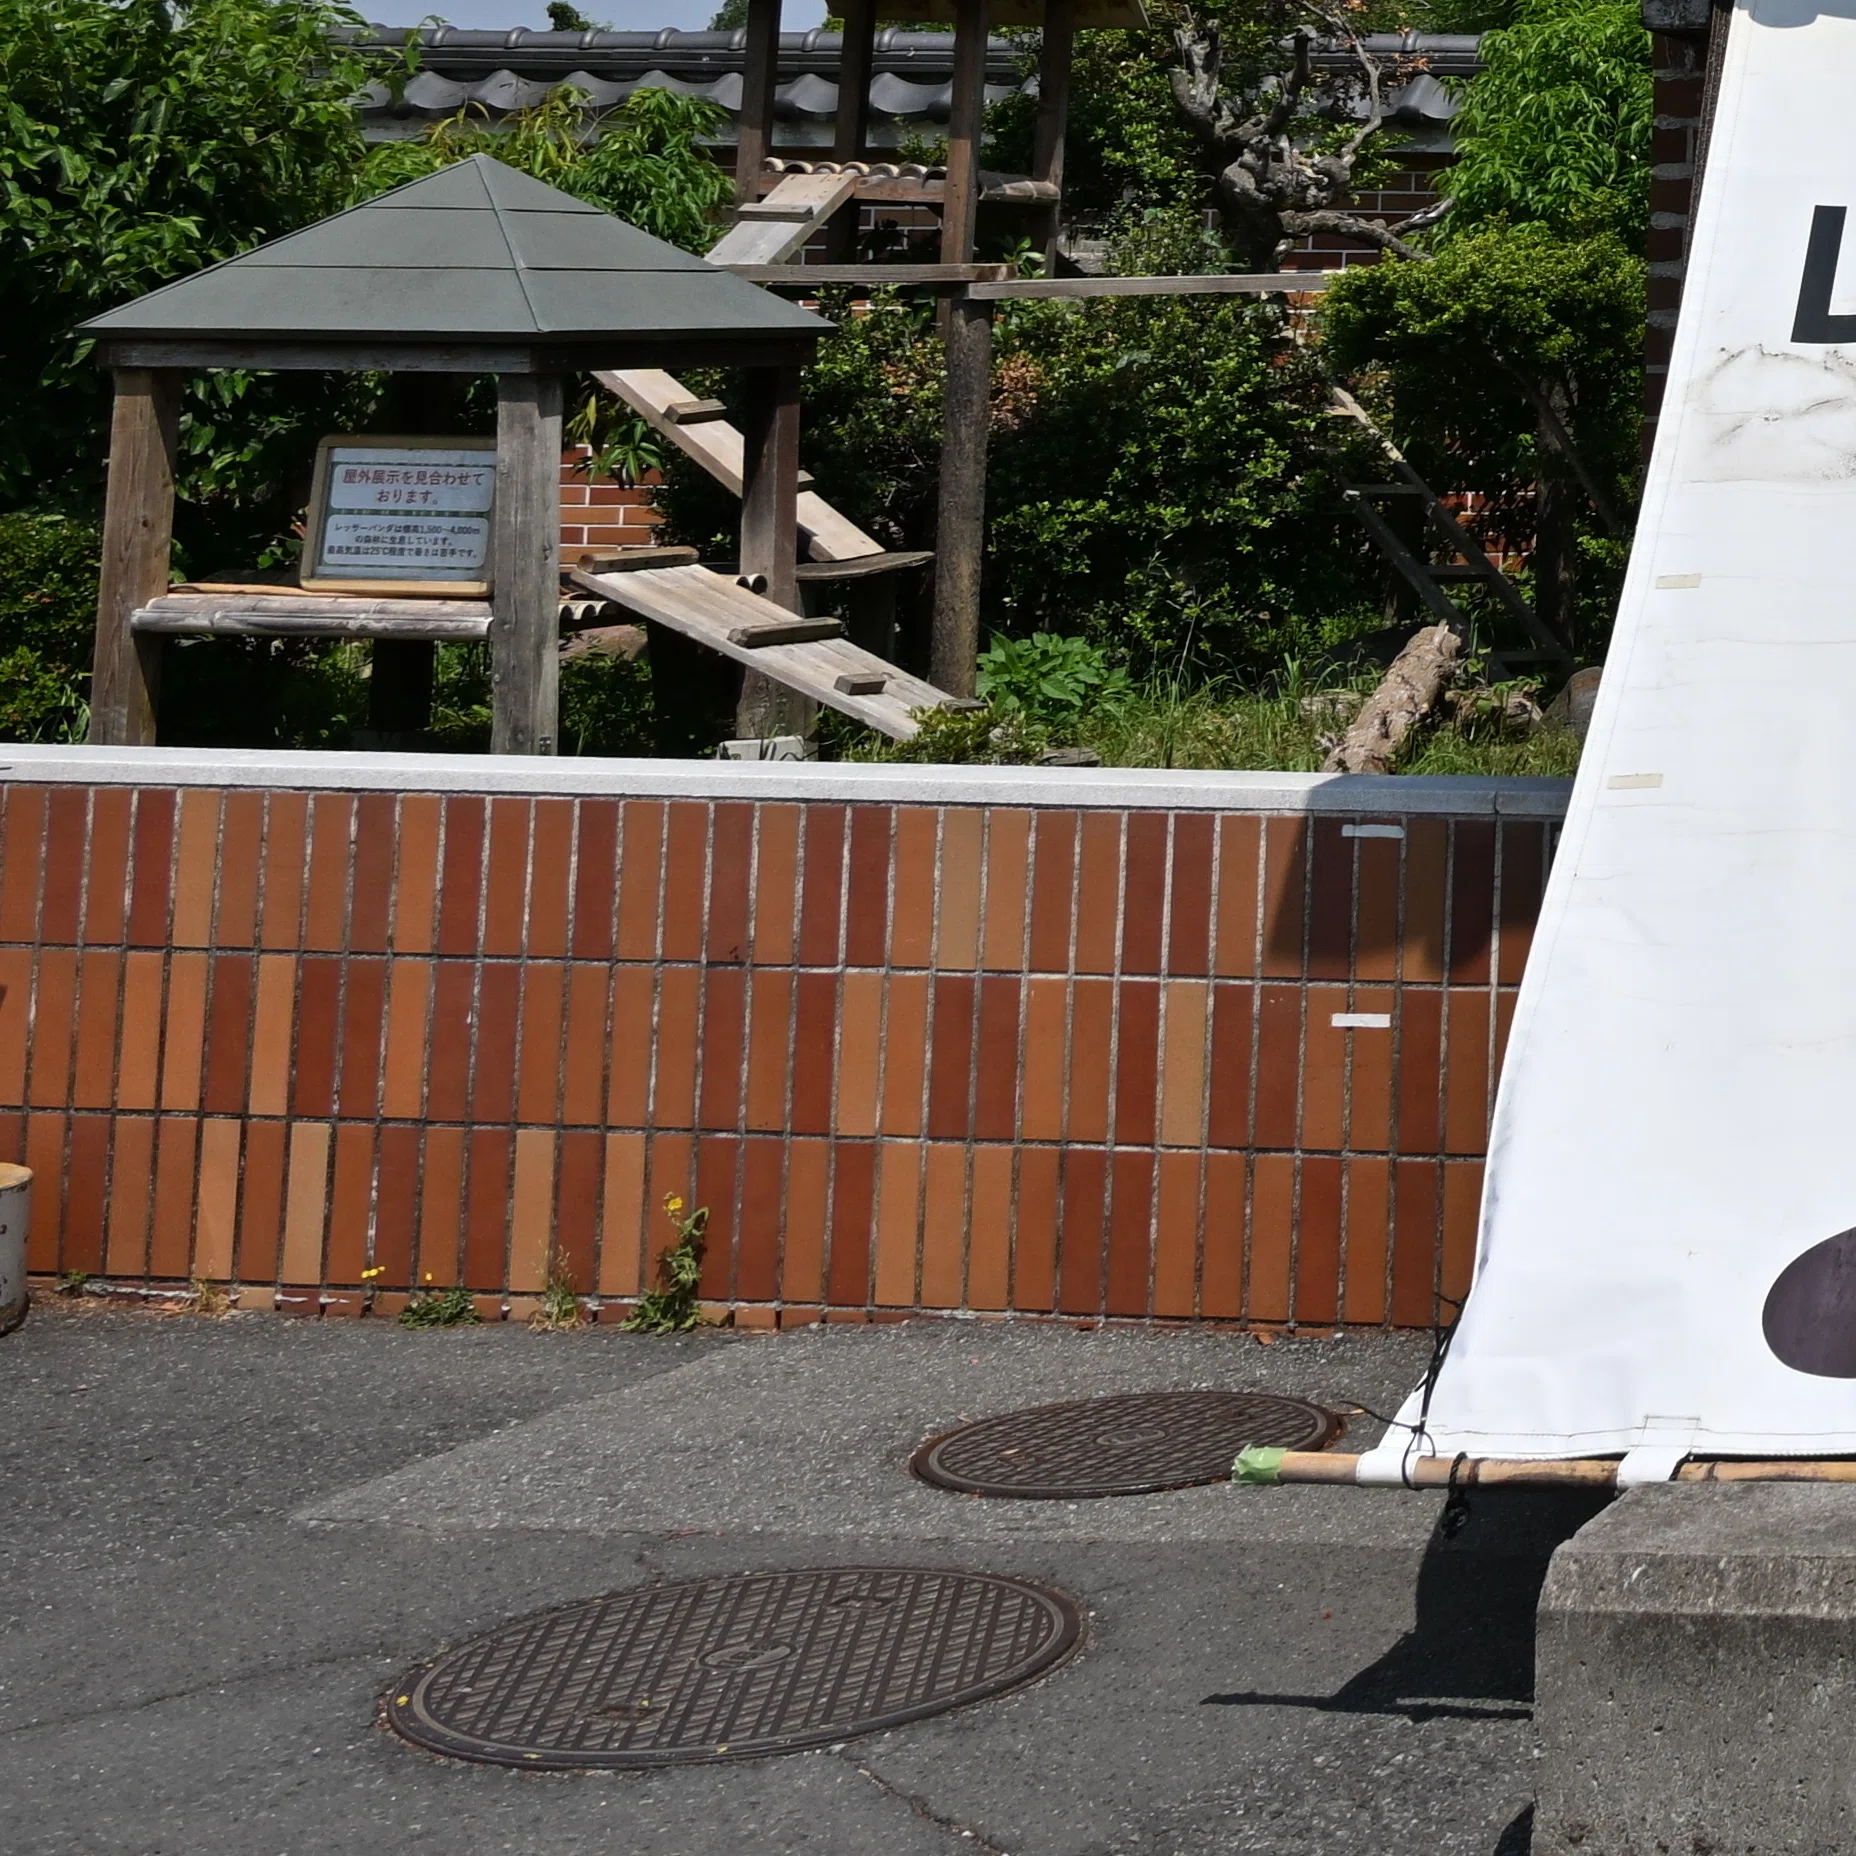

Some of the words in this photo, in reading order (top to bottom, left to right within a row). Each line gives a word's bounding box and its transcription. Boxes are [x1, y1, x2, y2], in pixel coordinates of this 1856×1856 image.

[342, 468, 486, 486] 屋外展示を見合わせて
[376, 489, 439, 505] おります。
